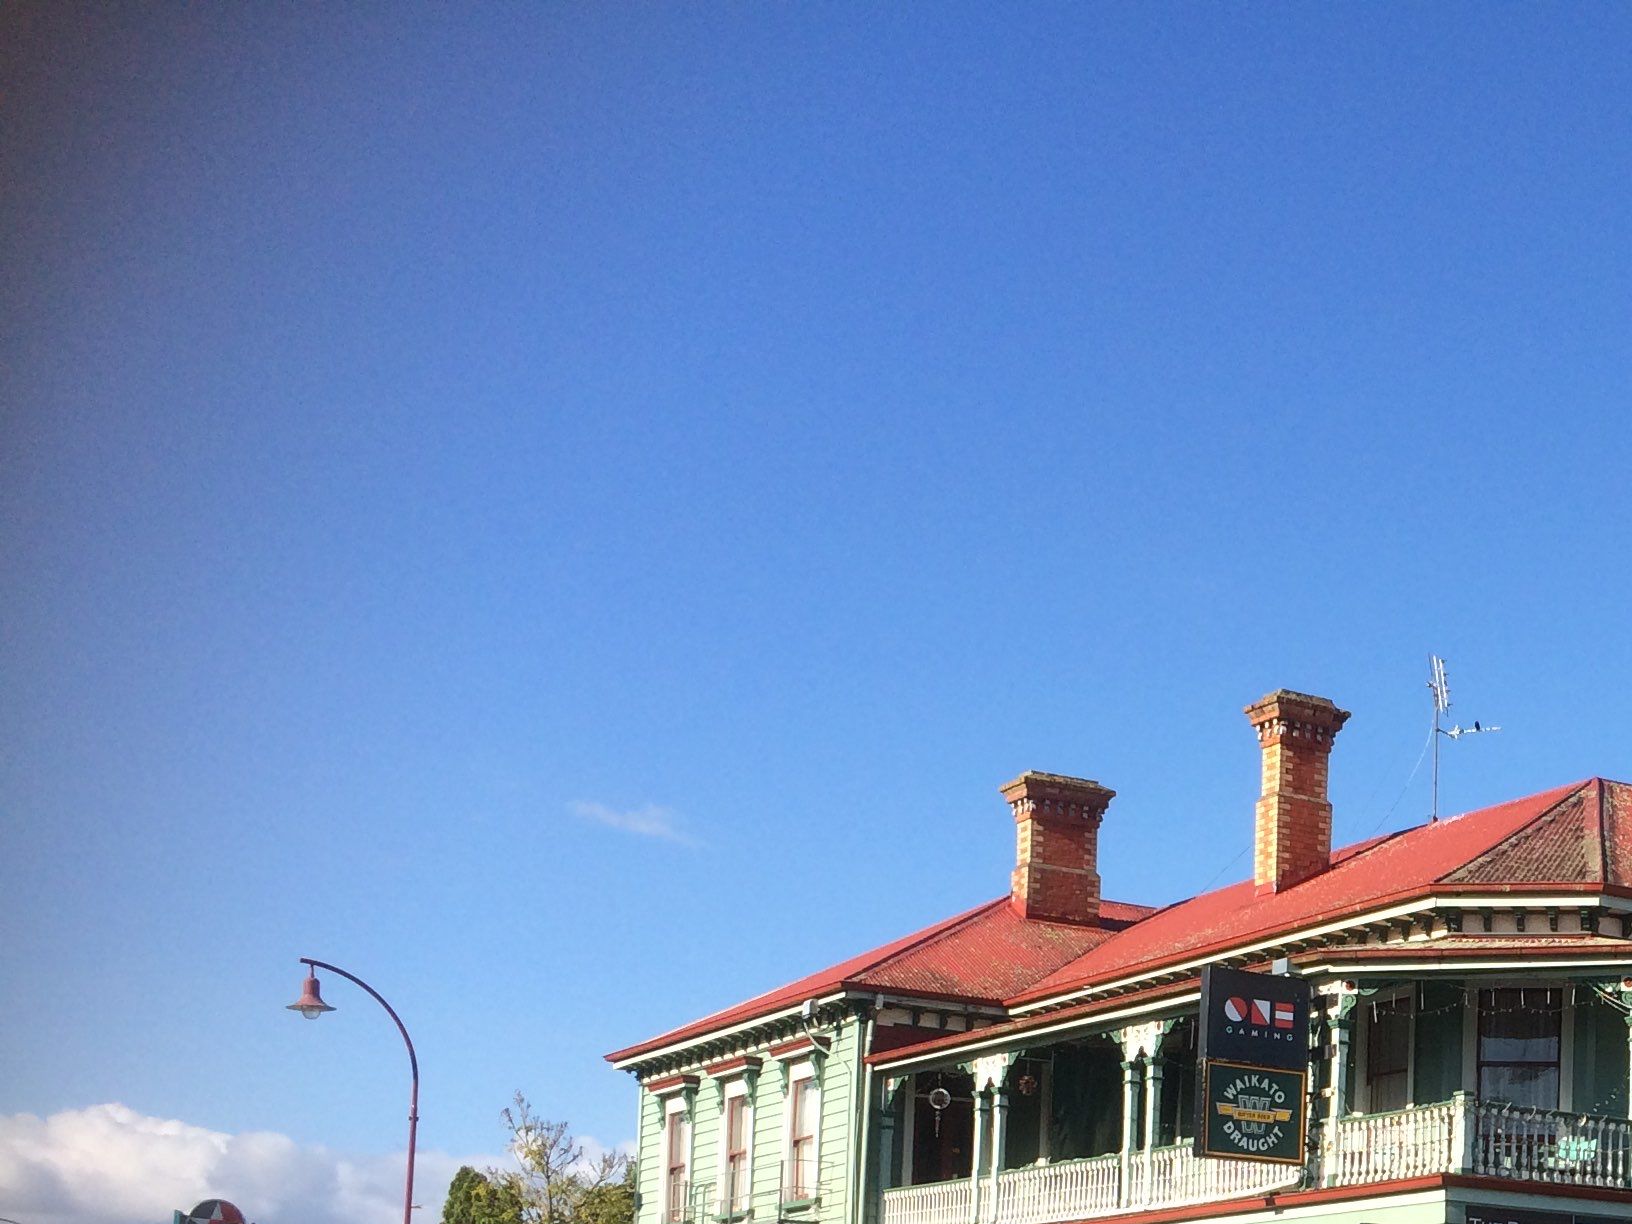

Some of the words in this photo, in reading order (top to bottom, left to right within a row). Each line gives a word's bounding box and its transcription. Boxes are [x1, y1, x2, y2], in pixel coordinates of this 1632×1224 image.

[1225, 1025, 1294, 1042] GAMING
[1223, 1074, 1286, 1104] WAIKATO
[1222, 1120, 1285, 1152] DRAUGHT
